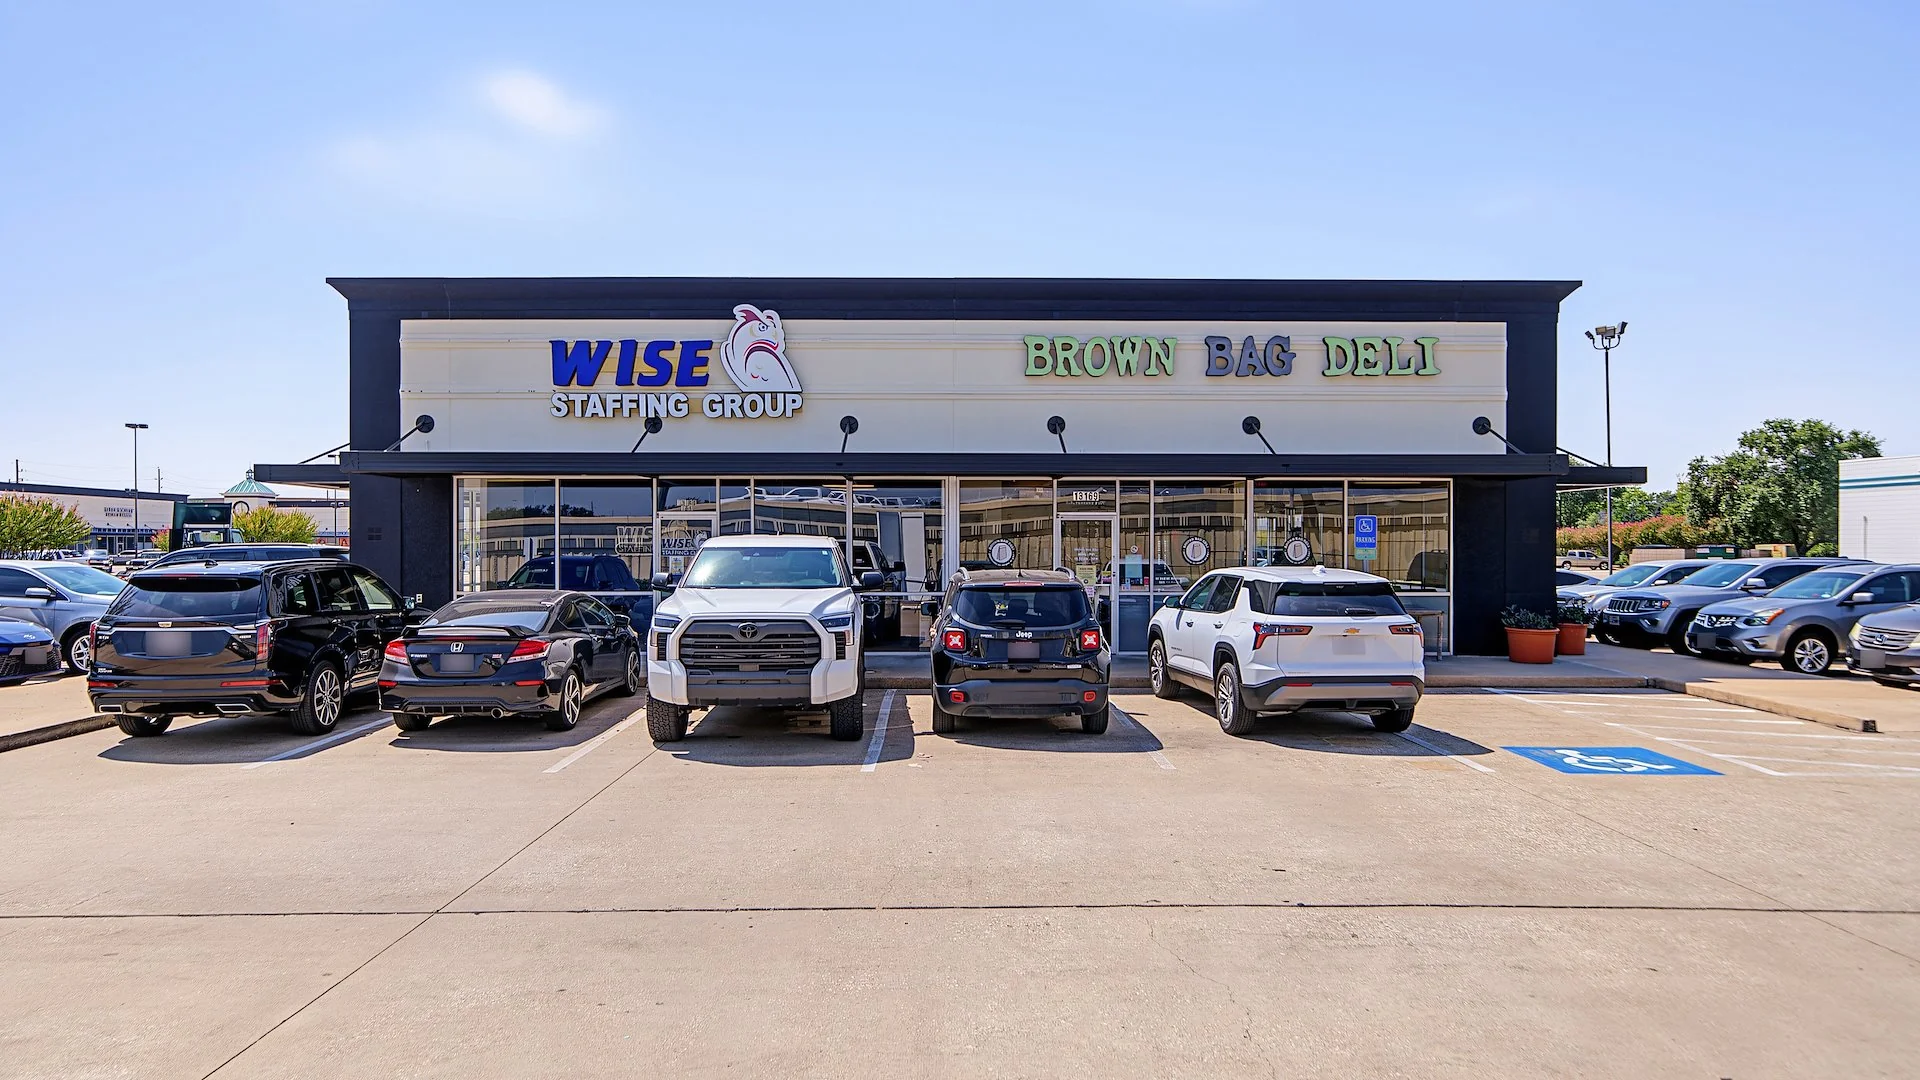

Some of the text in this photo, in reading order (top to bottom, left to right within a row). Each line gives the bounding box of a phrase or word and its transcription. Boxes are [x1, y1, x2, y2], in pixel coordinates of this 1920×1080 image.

[549, 339, 713, 387] WISE
[1023, 335, 1442, 377] BROWN BAG DELI
[550, 392, 803, 418] STAFFING GROUP
[662, 538, 691, 549] WISE
[1015, 630, 1033, 639] Jeep
